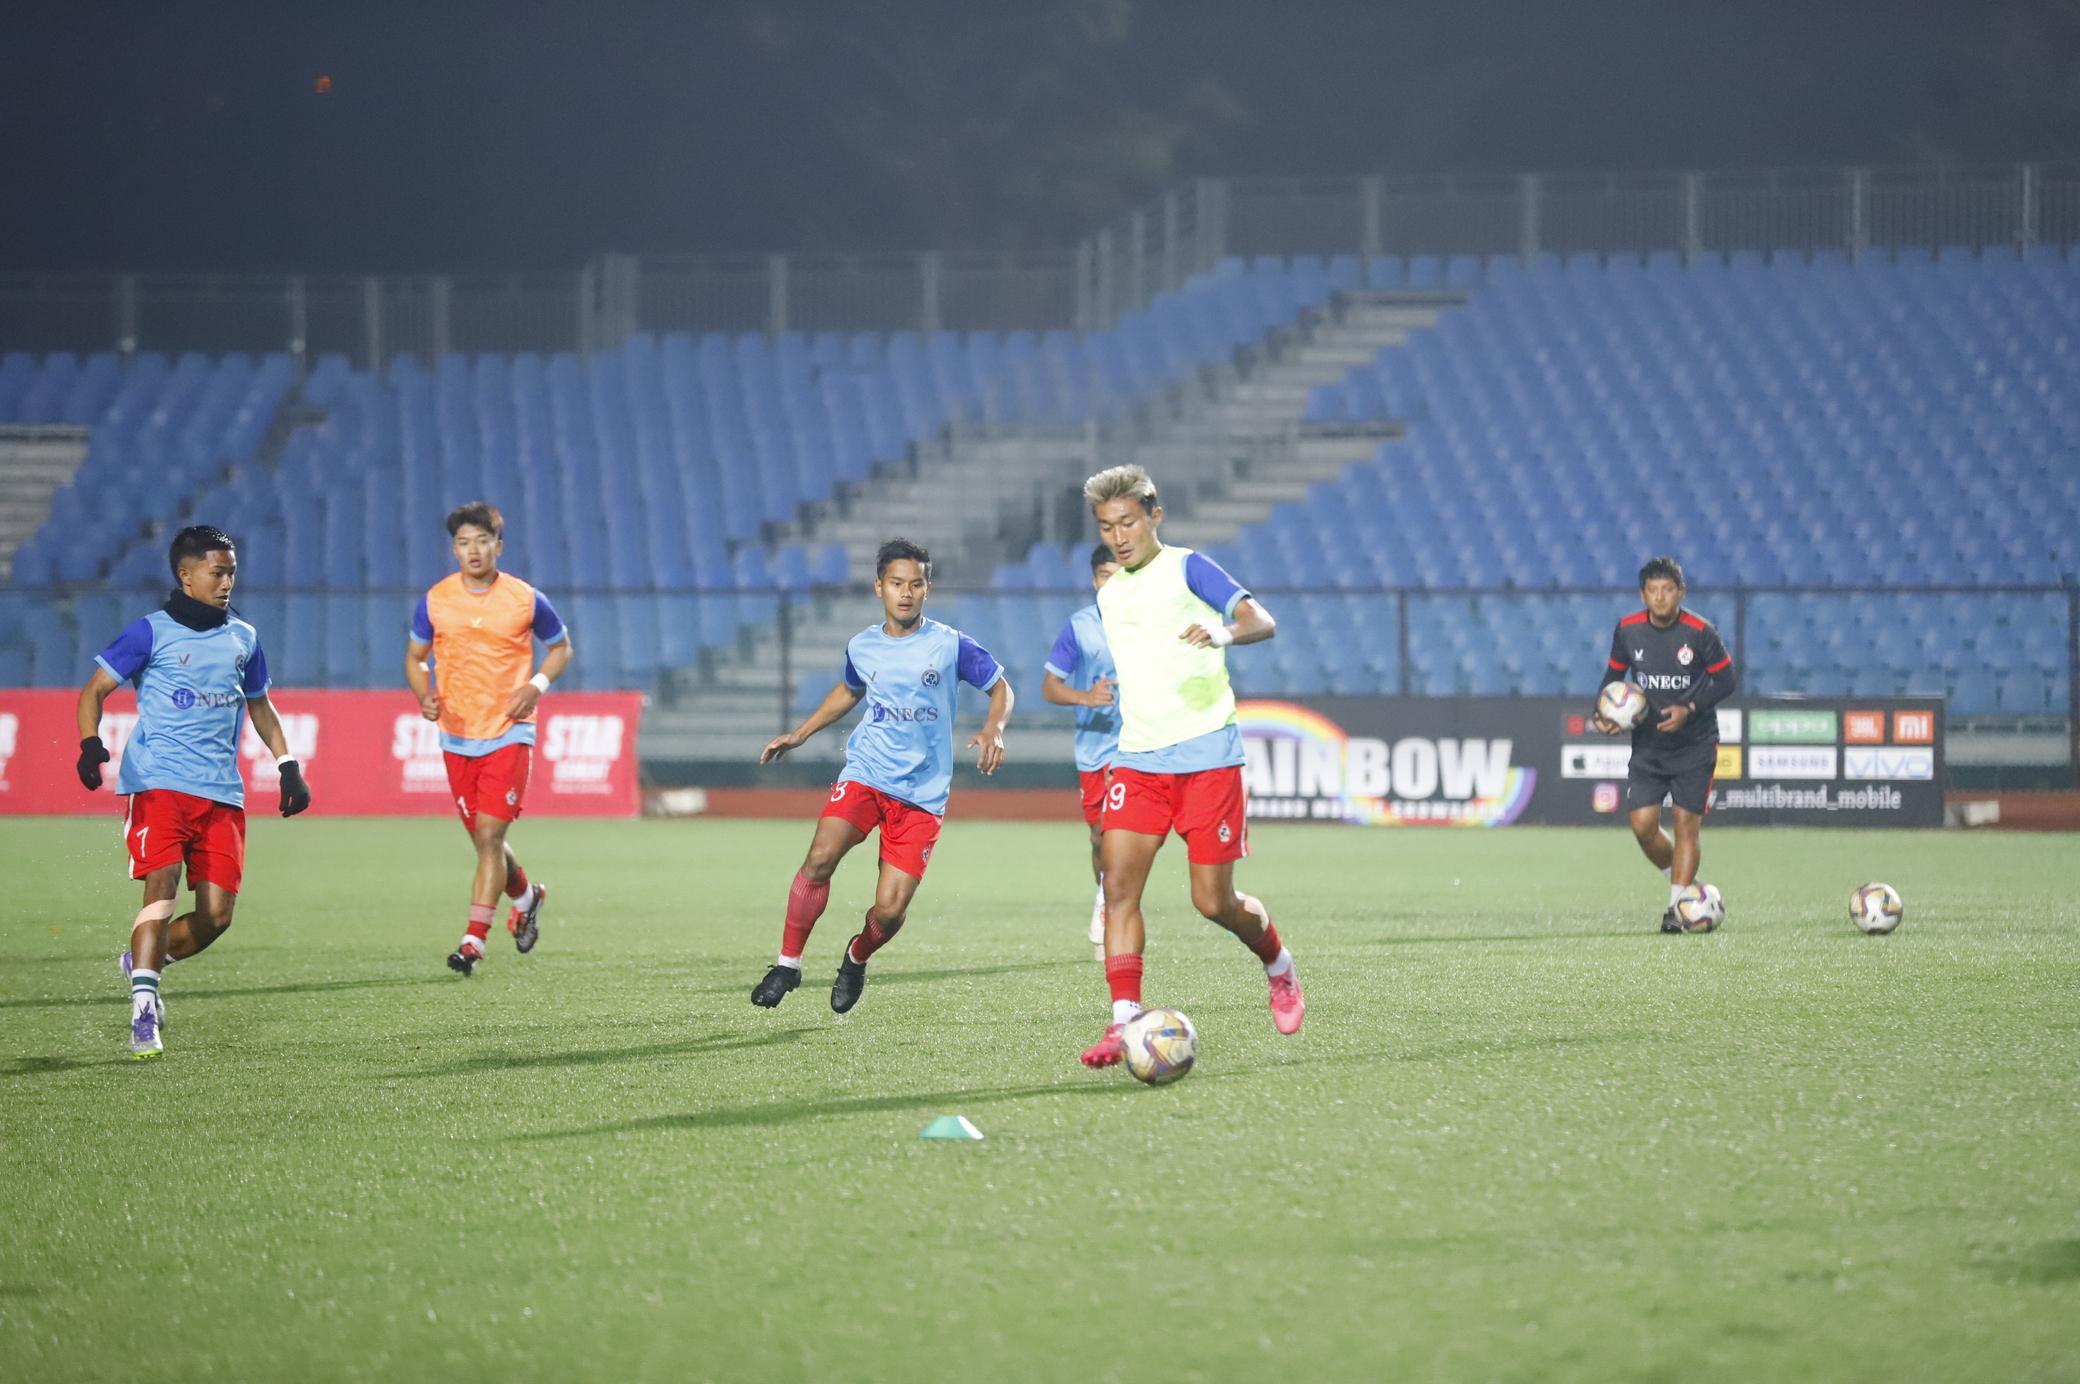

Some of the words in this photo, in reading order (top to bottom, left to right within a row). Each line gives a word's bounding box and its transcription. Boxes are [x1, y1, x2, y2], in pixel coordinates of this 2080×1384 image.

[1648, 674, 1691, 690] NECS
[887, 706, 938, 722] NECS
[543, 714, 624, 762] STAR
[1245, 737, 1513, 799] AINBOW
[1757, 755, 1830, 768] SAMSUNG
[136, 826, 150, 858] 7
